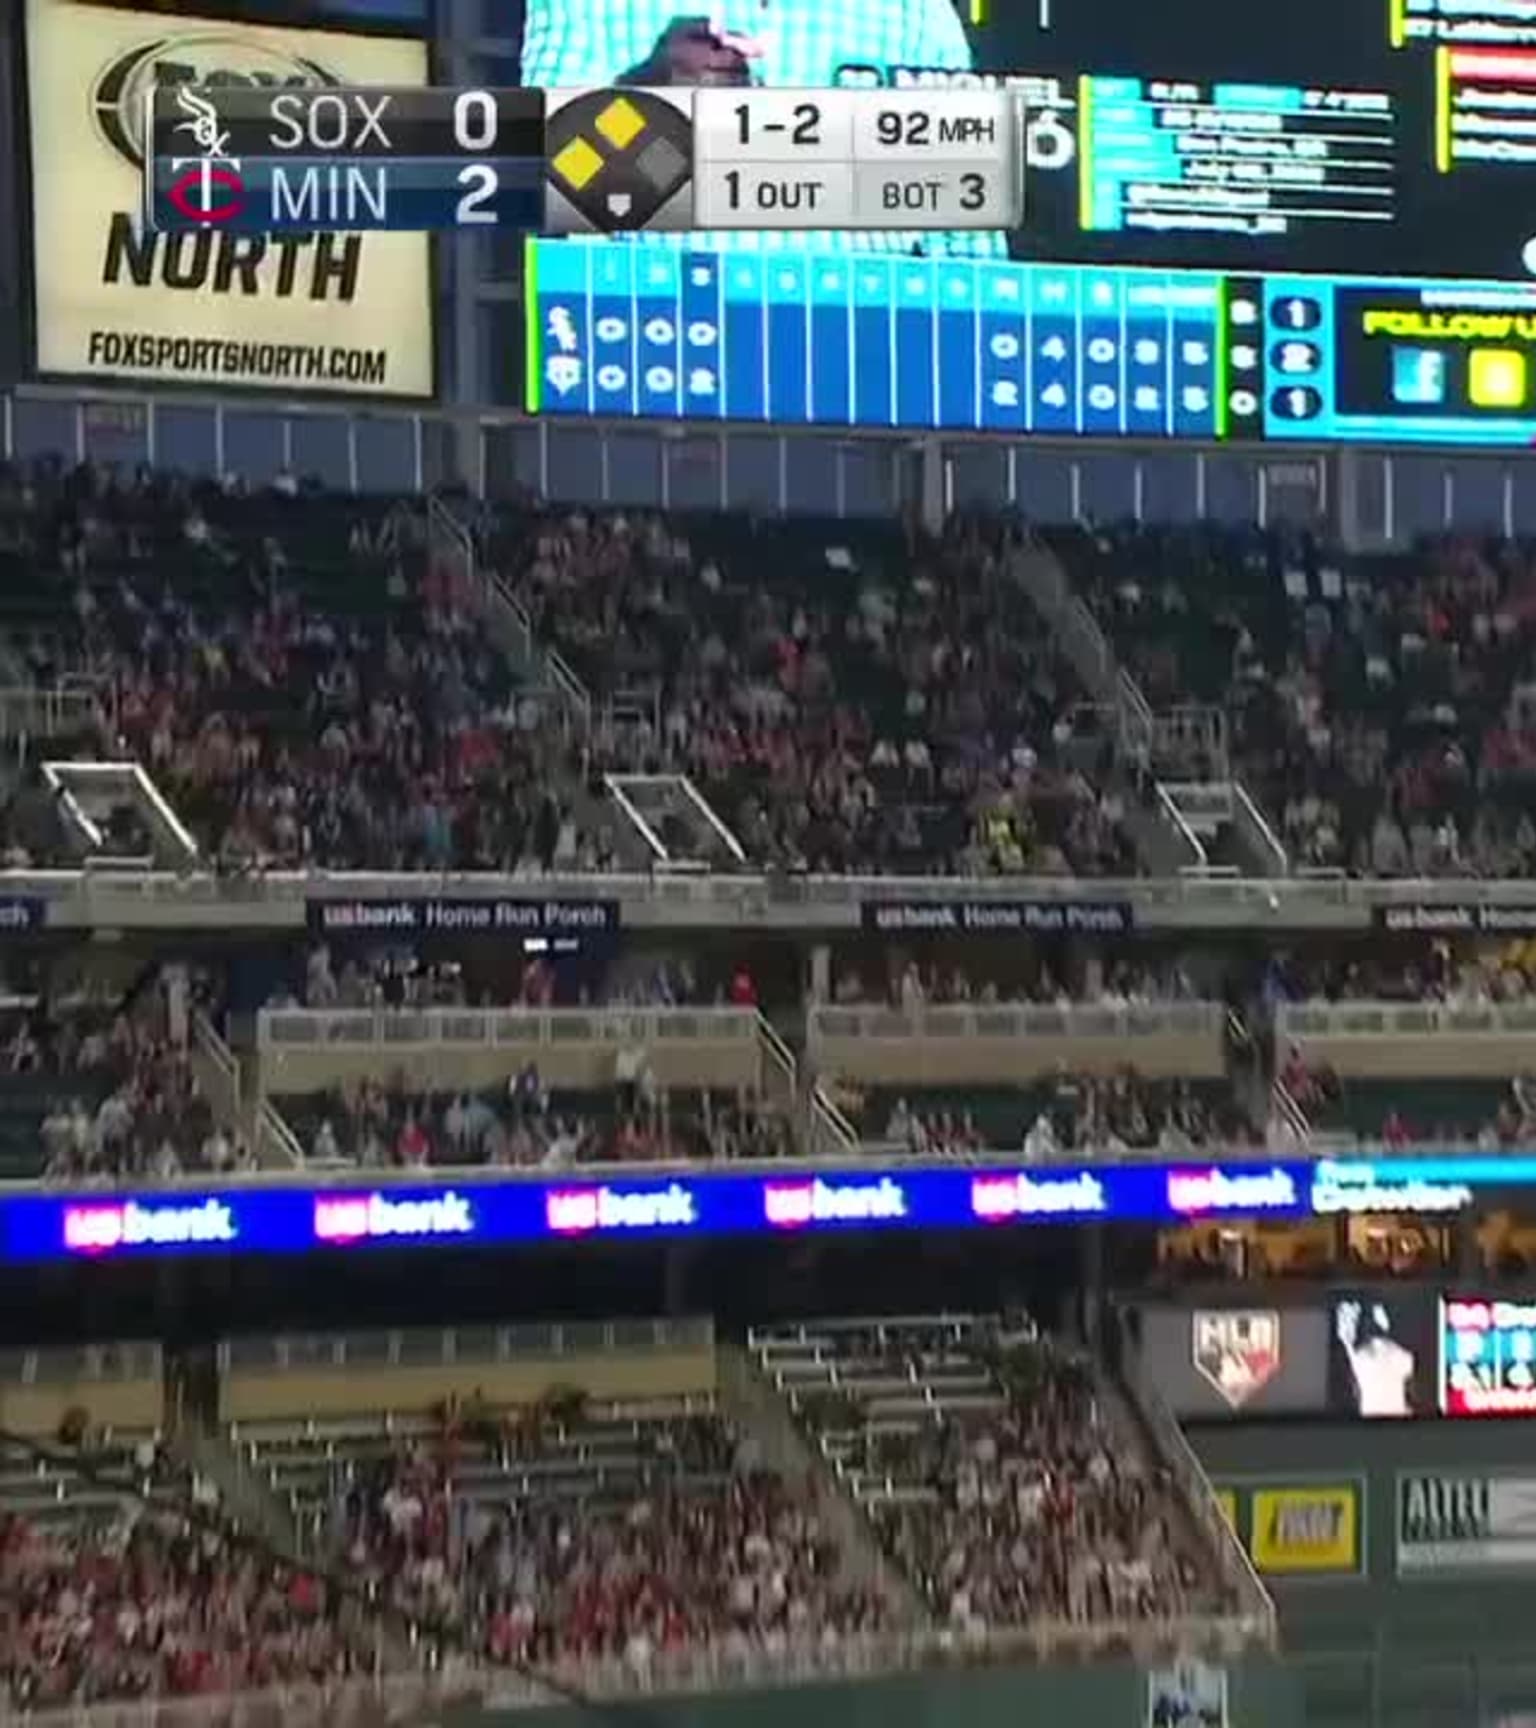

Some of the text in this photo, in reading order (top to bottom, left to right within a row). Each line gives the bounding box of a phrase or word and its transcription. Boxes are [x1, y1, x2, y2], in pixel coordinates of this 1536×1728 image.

[102, 211, 364, 302] NORTH
[88, 331, 387, 385] FOXSPORTSNORTH.COM
[426, 903, 491, 927] Home
[494, 903, 539, 926] Run
[544, 903, 606, 927] Porch
